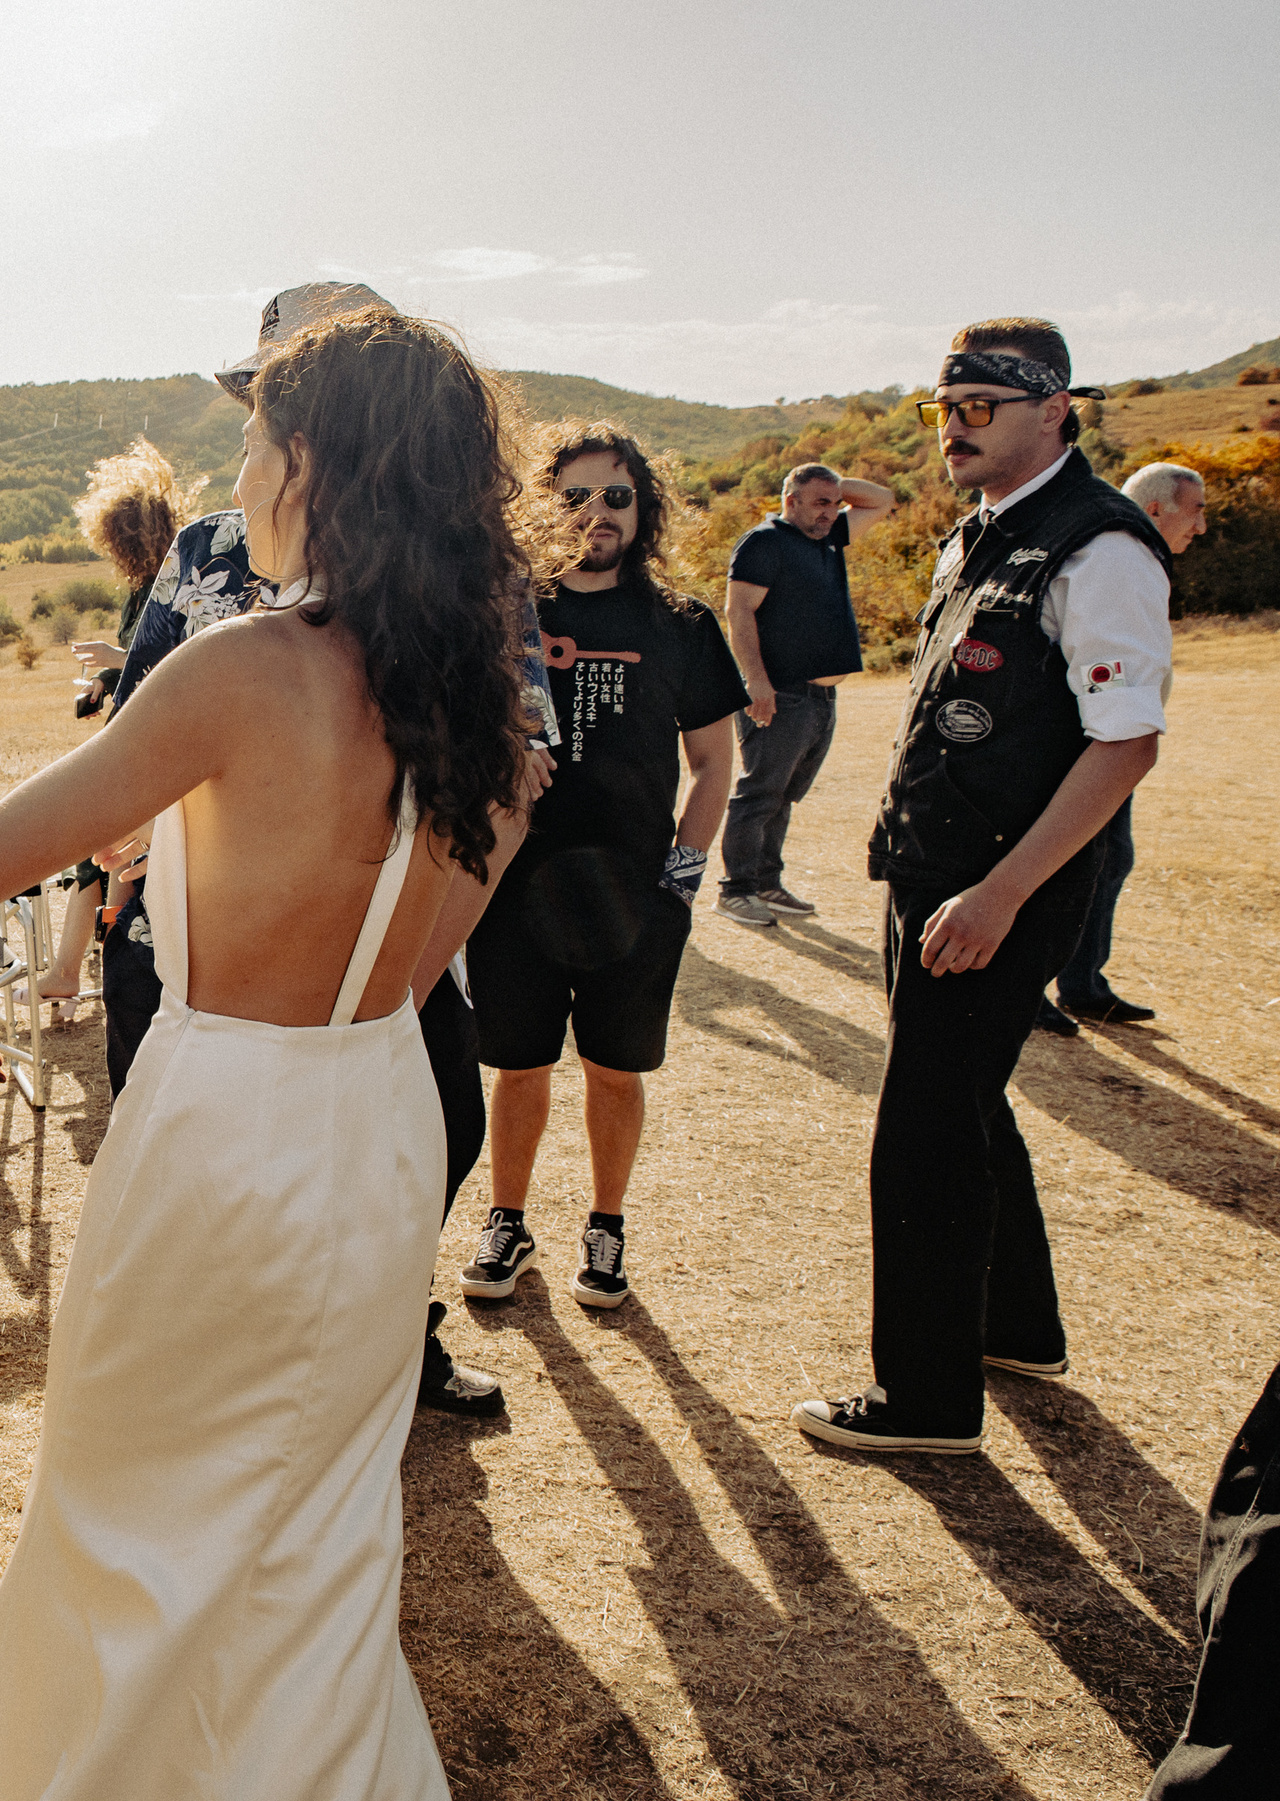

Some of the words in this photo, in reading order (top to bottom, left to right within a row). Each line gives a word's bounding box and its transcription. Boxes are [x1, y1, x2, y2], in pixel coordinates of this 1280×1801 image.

[955, 641, 998, 669] AC/DC
[600, 662, 612, 703] 若い女性
[613, 663, 625, 715] より速い馬
[571, 661, 585, 762] そしてより多くのお金
